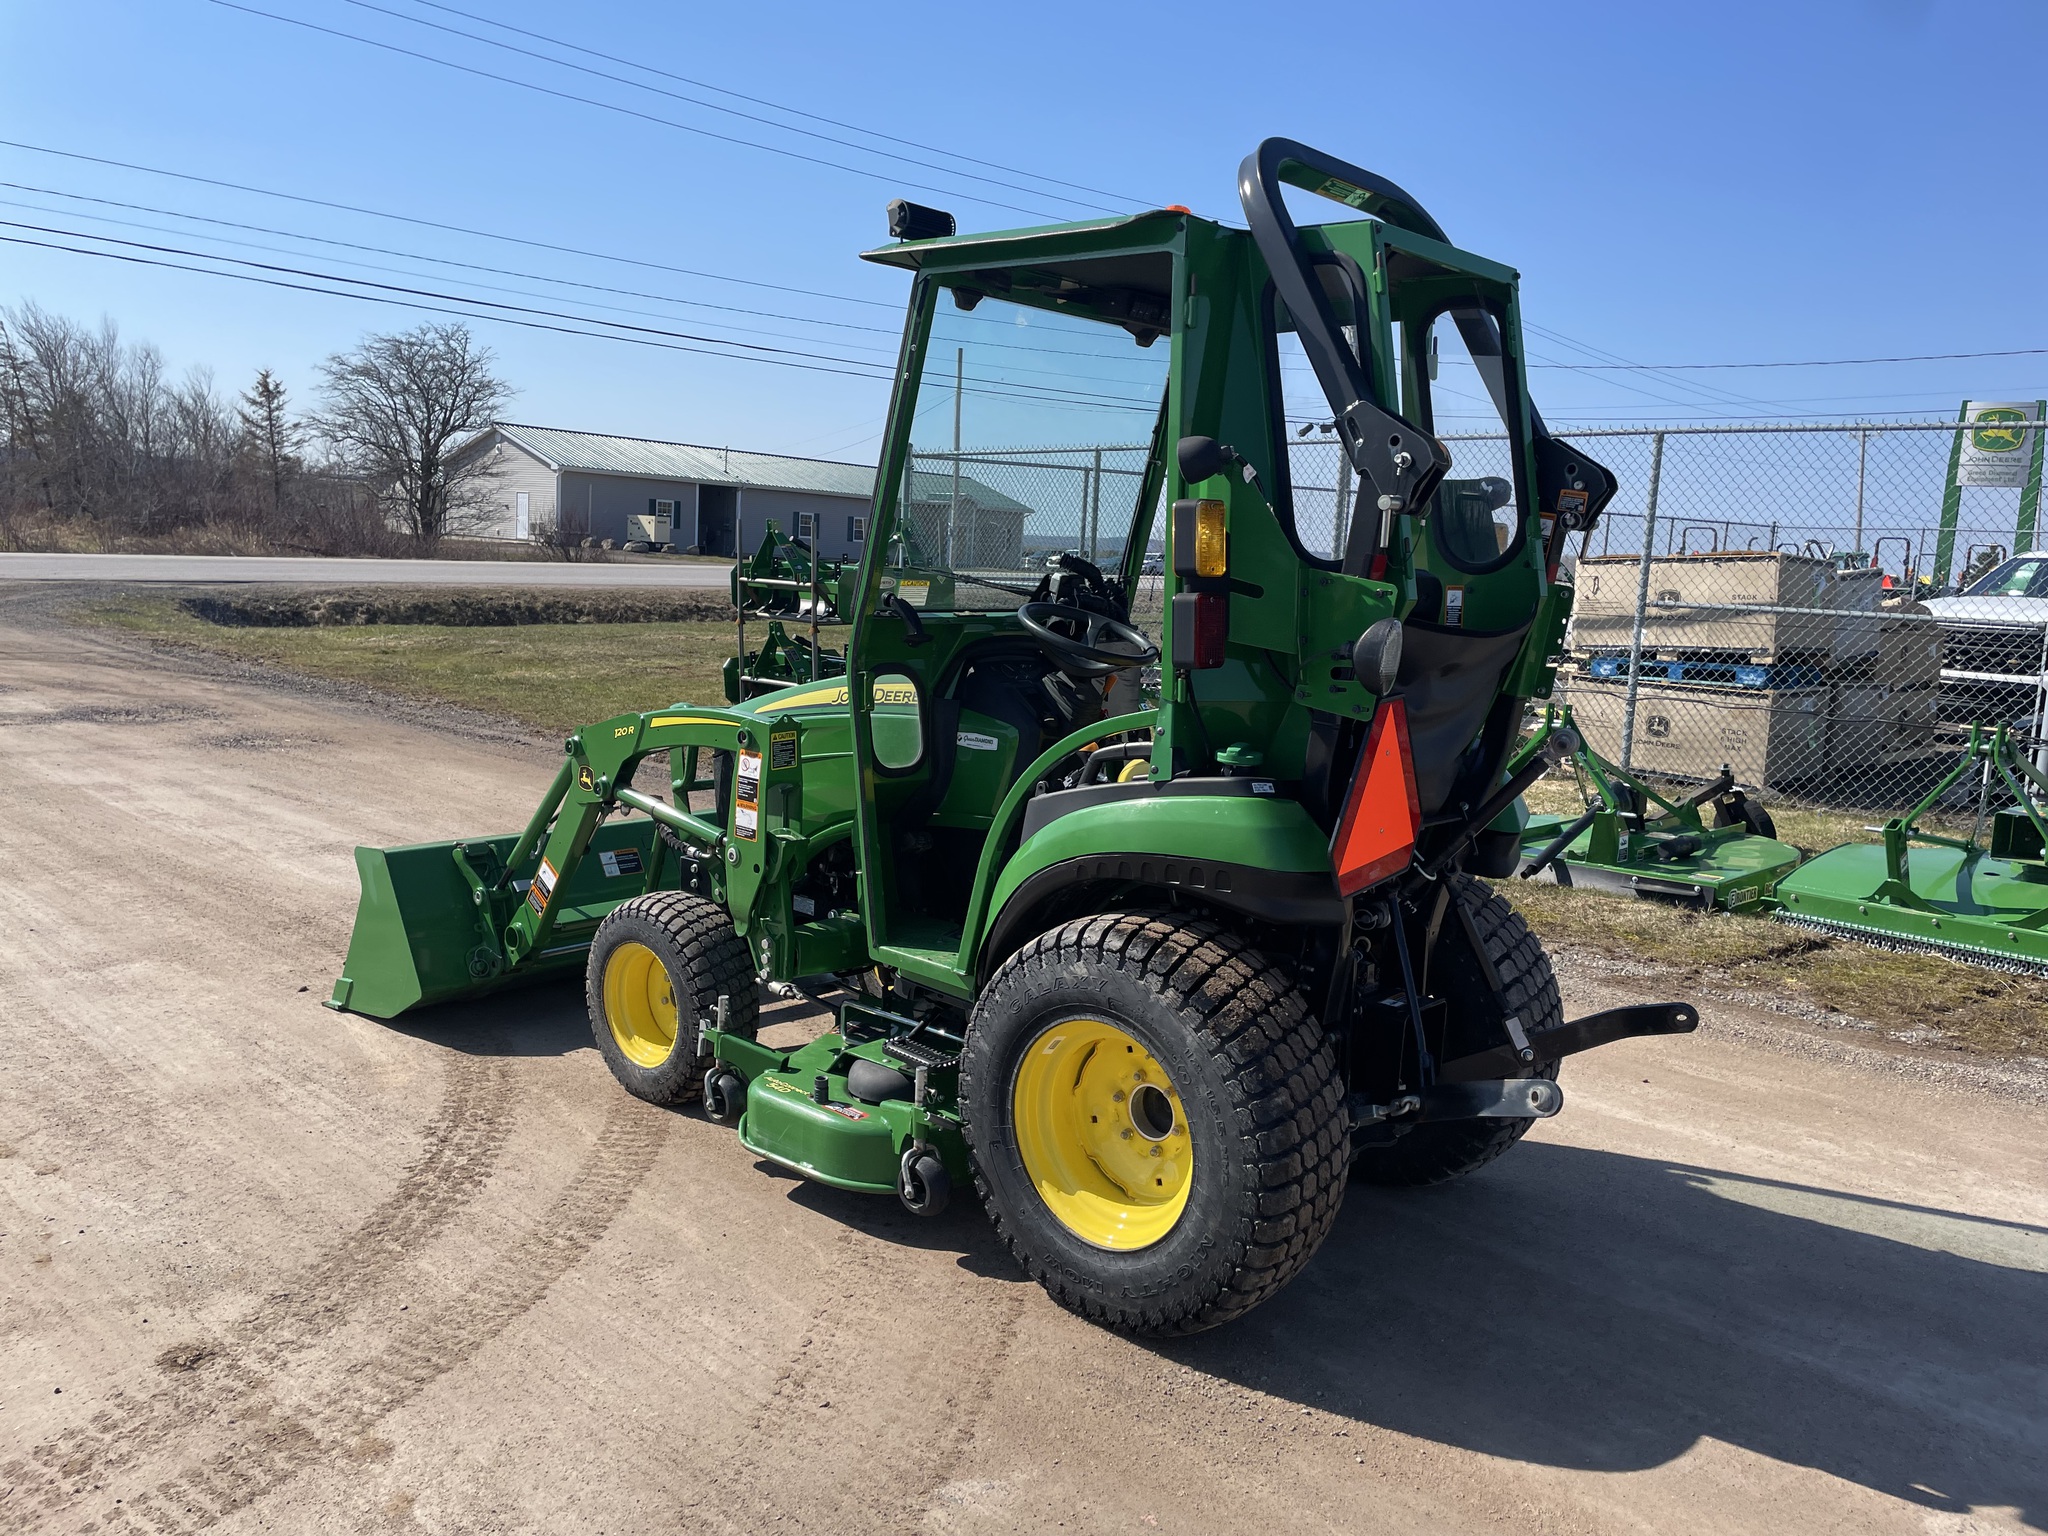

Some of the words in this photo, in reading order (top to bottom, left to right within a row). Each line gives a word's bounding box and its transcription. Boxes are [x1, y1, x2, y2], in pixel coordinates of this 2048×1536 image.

[875, 688, 918, 702] DEERE
[1008, 975, 1110, 1015] GALAXY
[1043, 1253, 1104, 1294] MOW
[1120, 1232, 1217, 1300] MIGHTY
